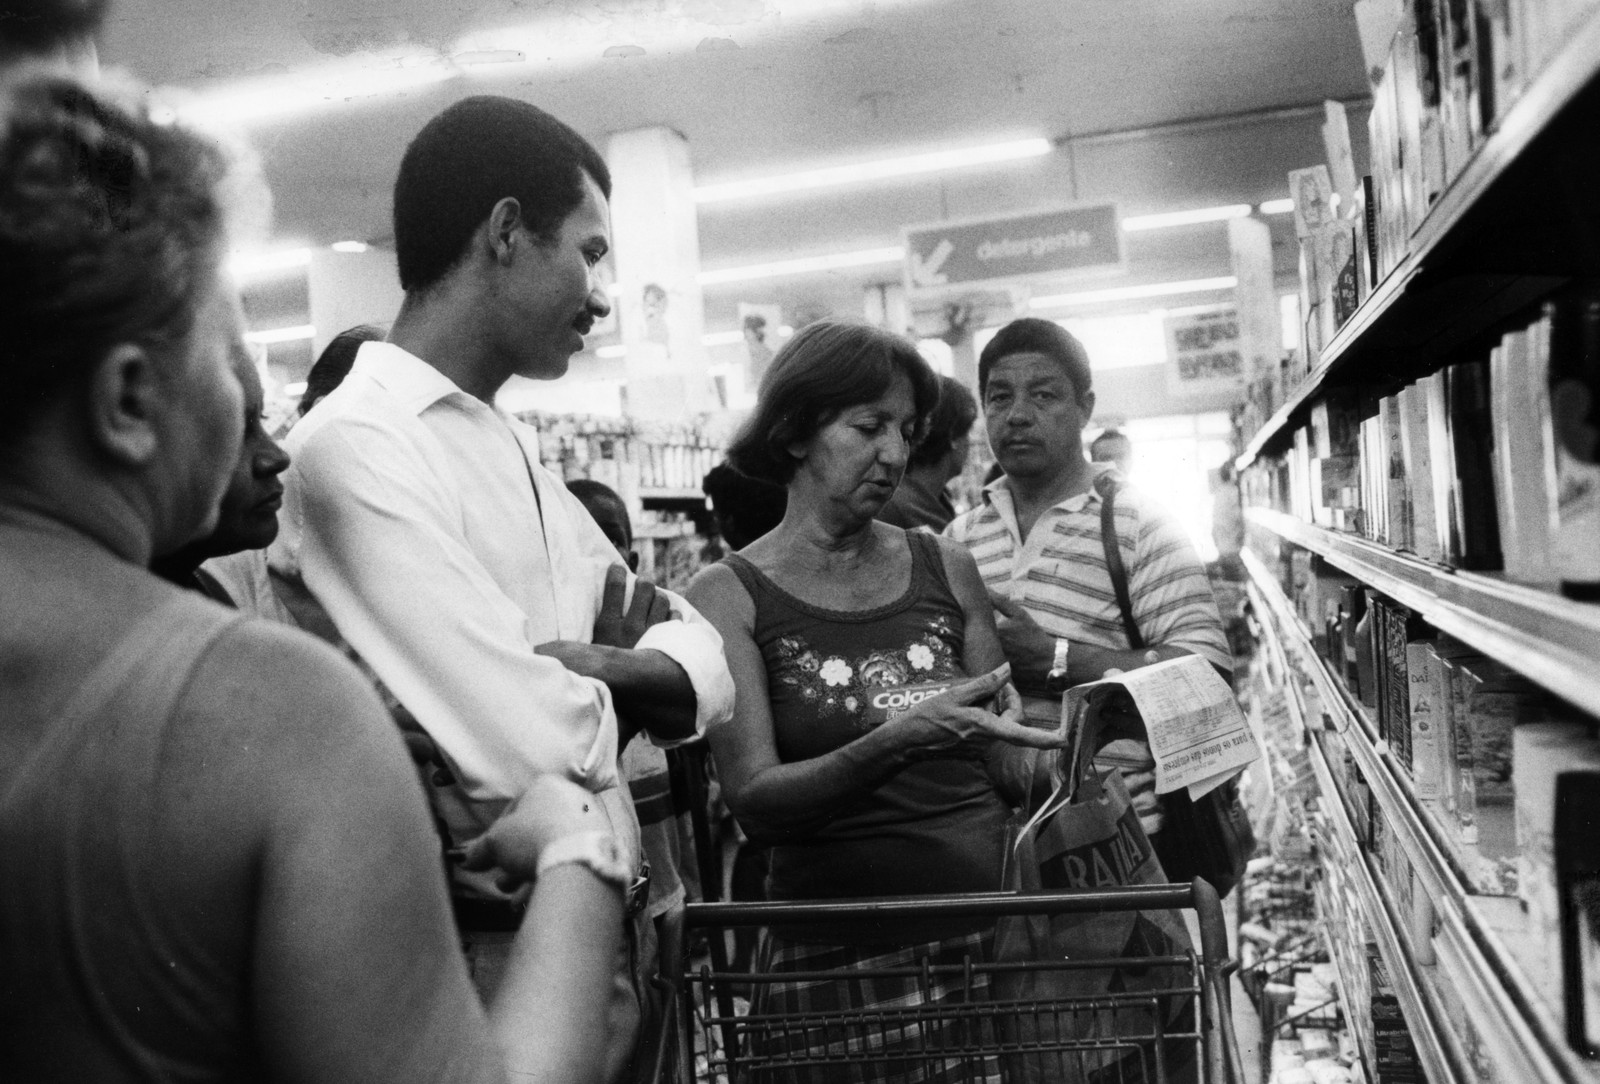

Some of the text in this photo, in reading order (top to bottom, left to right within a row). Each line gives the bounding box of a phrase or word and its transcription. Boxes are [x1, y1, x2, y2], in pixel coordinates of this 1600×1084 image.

[873, 688, 946, 709] Colga
[1233, 732, 1249, 745] para
[1203, 743, 1222, 757] donos
[1223, 741, 1231, 750] os
